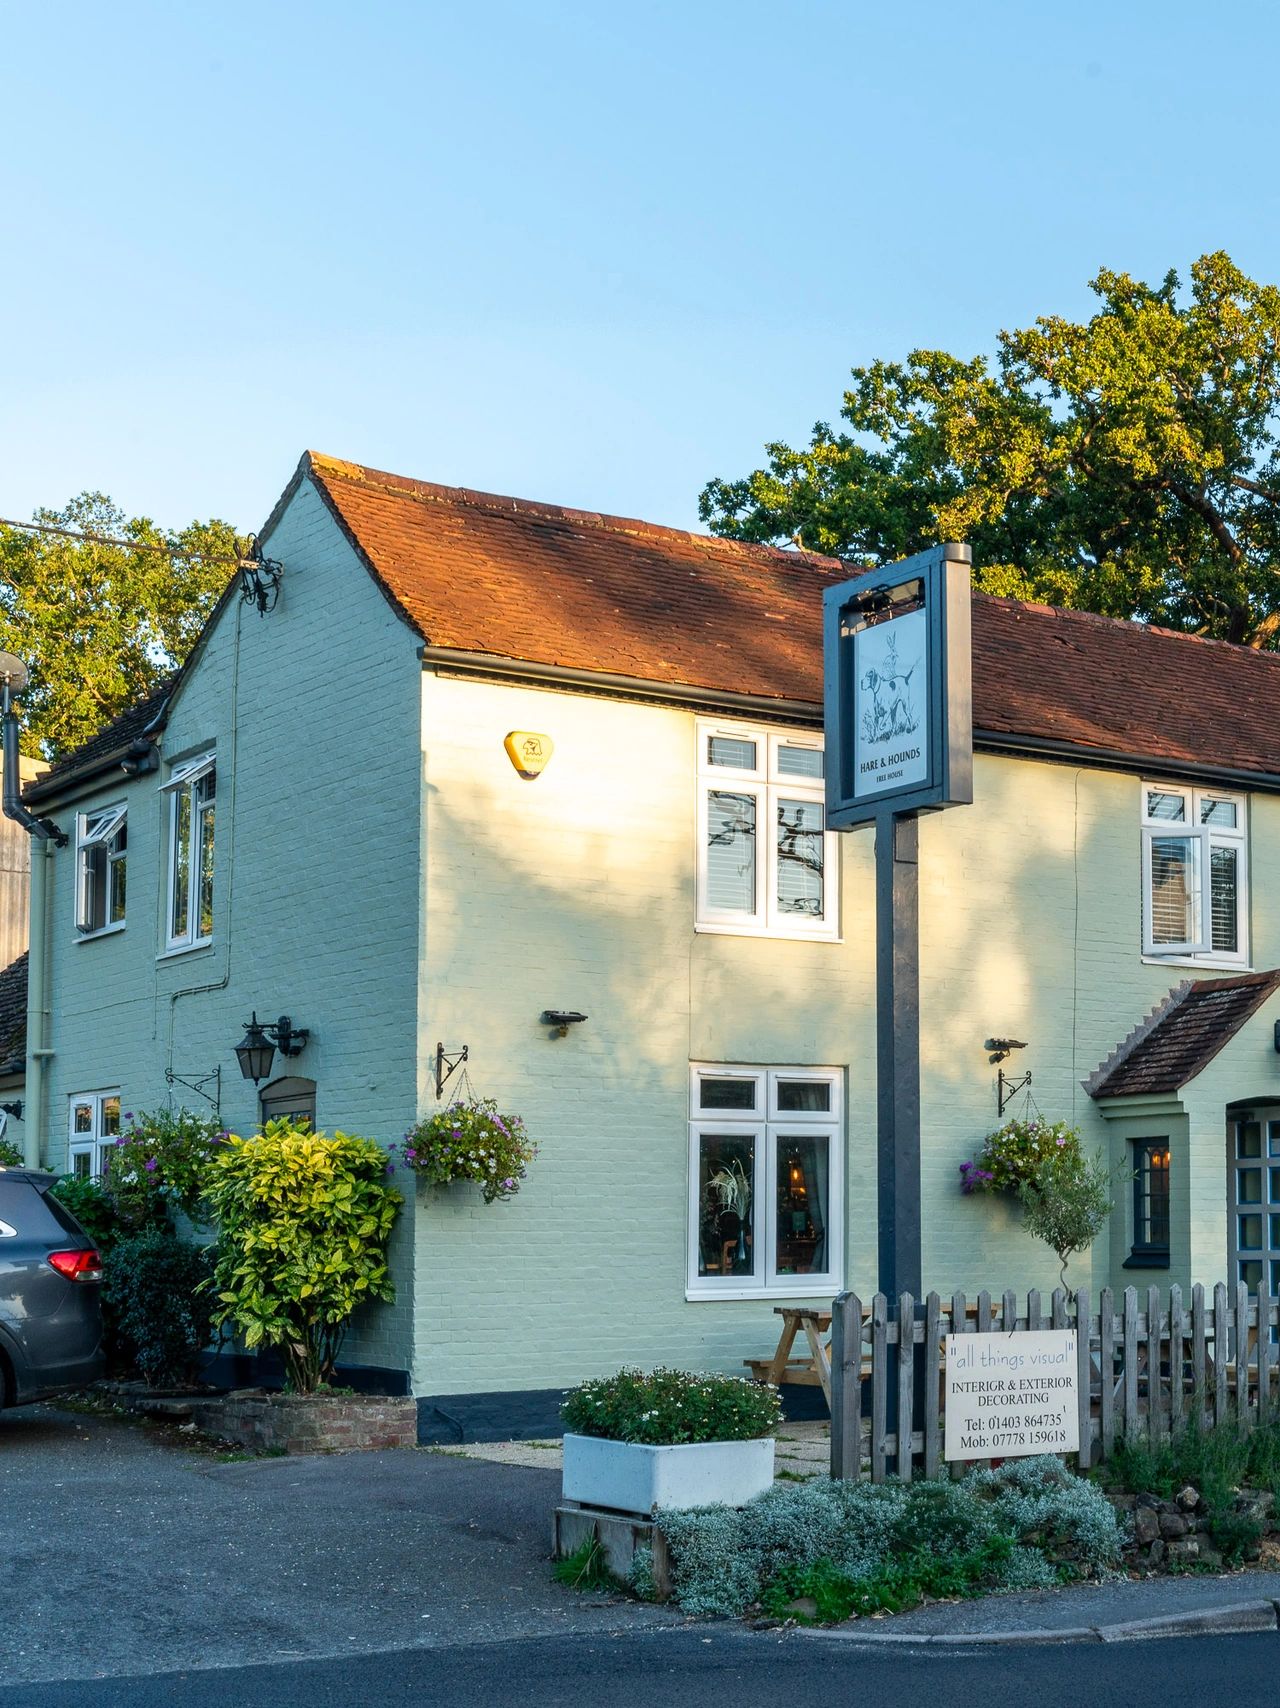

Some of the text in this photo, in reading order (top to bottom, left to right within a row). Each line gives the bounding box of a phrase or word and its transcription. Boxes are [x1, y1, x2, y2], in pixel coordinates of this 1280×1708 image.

[860, 747, 921, 774] HARE & HOUNDS
[876, 770, 904, 783] FREE HOUSE
[980, 1344, 1024, 1370] things
[952, 1377, 1073, 1394] INTERIOR & EXTERIOR
[978, 1393, 1049, 1407] DECORATING
[965, 1413, 1062, 1431] Tel: 01403 864735
[960, 1429, 1066, 1449] Mob: 07778 159618
